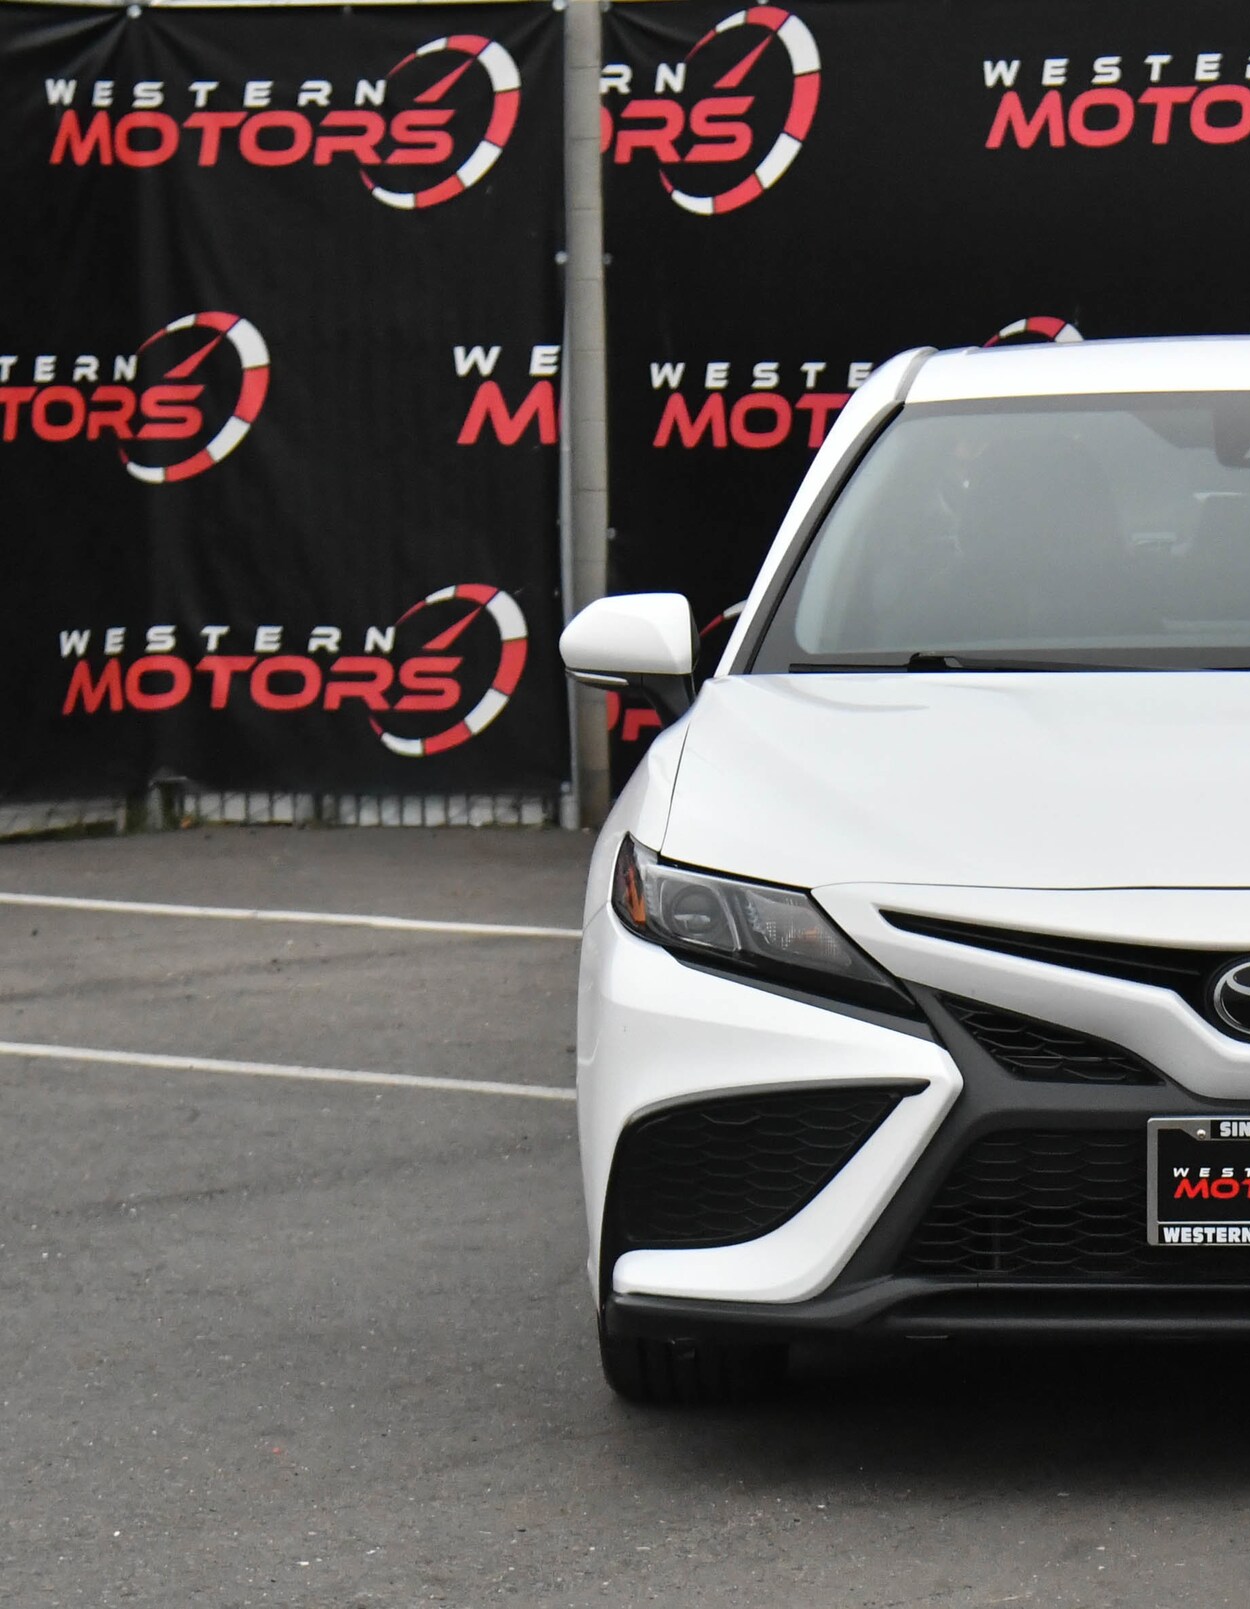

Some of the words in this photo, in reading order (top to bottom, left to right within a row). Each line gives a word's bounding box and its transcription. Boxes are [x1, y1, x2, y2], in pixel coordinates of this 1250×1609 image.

[45, 78, 386, 108] WESTERN
[50, 109, 455, 168] MOTORS
[60, 625, 396, 658] WESTERN
[62, 654, 462, 715] MOTORS
